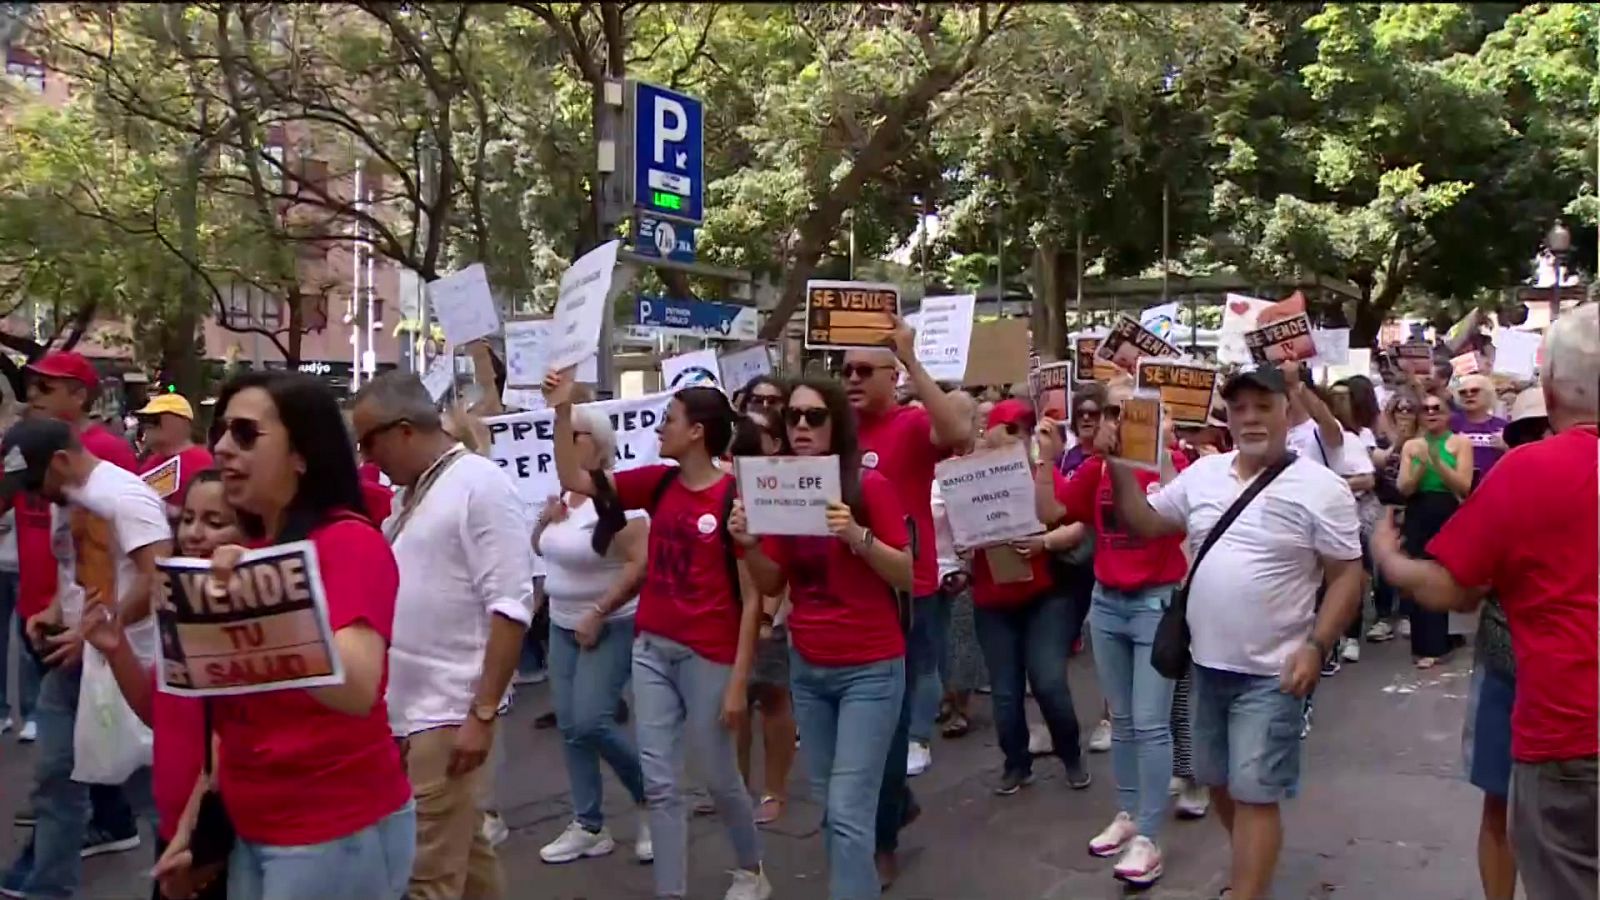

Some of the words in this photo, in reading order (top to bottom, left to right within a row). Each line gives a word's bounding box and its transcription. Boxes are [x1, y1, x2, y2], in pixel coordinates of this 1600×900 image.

[654, 95, 688, 163] P
[812, 289, 836, 308] SE
[840, 290, 896, 312] VENDE
[1264, 318, 1307, 342] VENDE
[1144, 366, 1165, 383] SE
[1168, 366, 1213, 389] VENDE
[756, 476, 778, 490] NO
[798, 476, 823, 490] EPE
[180, 557, 311, 615] VENDE
[220, 621, 265, 651] TU
